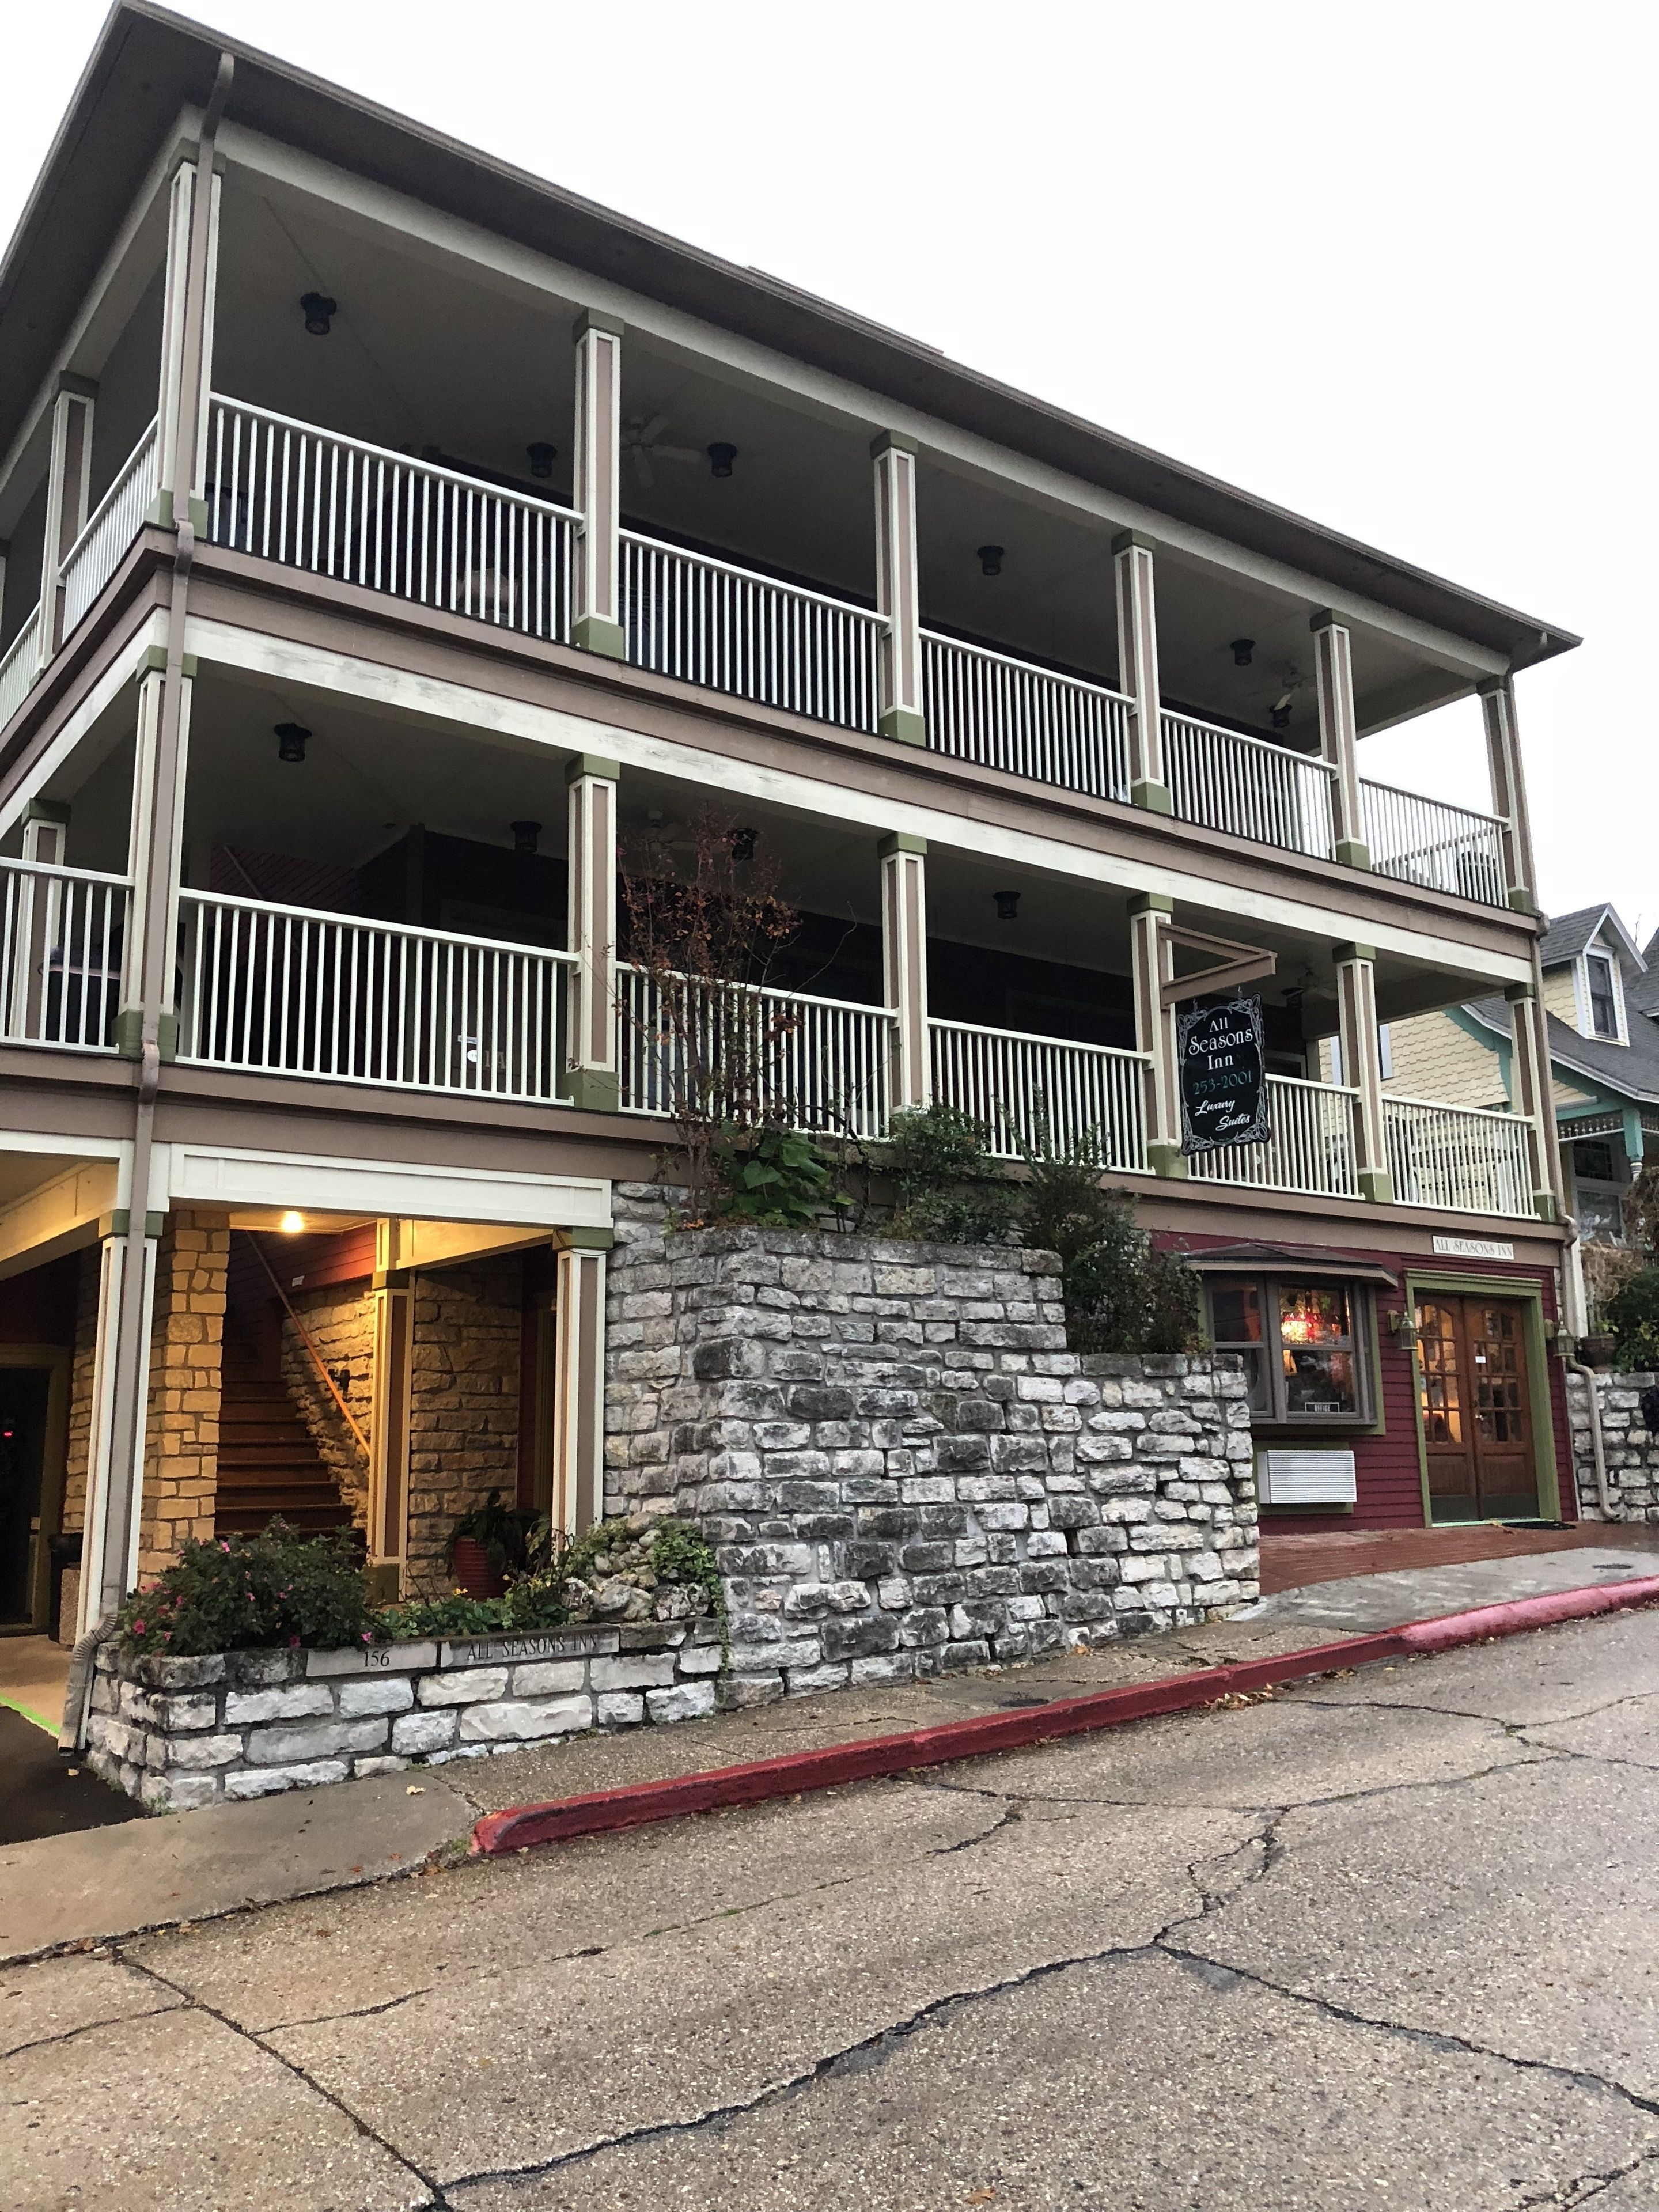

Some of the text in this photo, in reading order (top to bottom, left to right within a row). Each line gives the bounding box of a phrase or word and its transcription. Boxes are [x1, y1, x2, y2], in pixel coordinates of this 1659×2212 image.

[1209, 1017, 1228, 1033] All
[1188, 1028, 1253, 1055] Seasons
[1207, 1055, 1234, 1070] Inn
[1192, 1070, 1252, 1095] 253-2001
[1194, 1099, 1236, 1116] Luxury
[1215, 1113, 1251, 1131] Suites
[1435, 1239, 1513, 1257] ALL SEASONS INN
[467, 1632, 598, 1660] ALL SEASONS INN
[363, 1650, 390, 1668] 156
